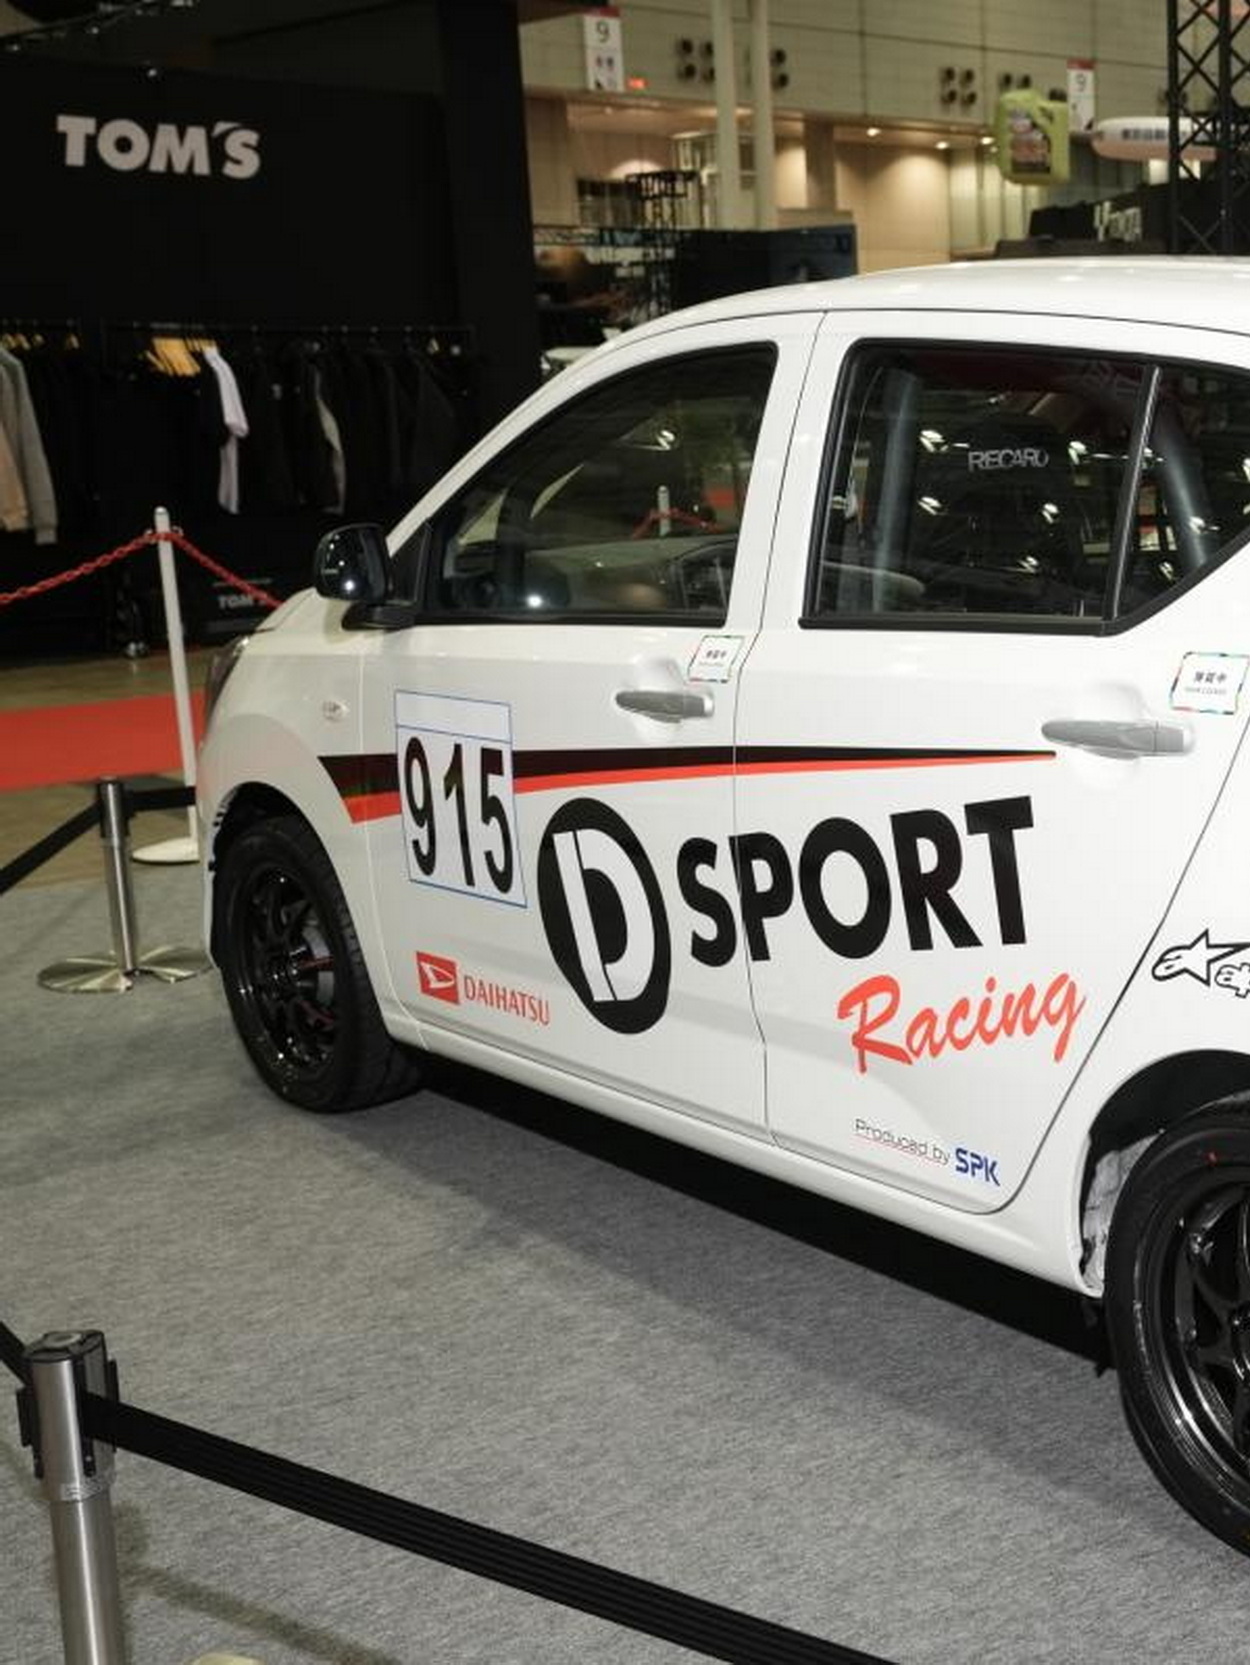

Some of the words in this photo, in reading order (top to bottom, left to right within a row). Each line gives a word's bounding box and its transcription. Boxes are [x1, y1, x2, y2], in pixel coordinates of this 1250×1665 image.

[56, 114, 260, 179] TOM'S
[968, 448, 1049, 472] RECARO
[404, 737, 513, 893] 915
[677, 795, 1034, 967] SPORT
[464, 974, 550, 1026] DAIHATSU
[836, 972, 1086, 1074] Racing
[855, 1118, 928, 1157] Produced
[932, 1144, 950, 1166] by
[955, 1147, 1000, 1187] SPK
